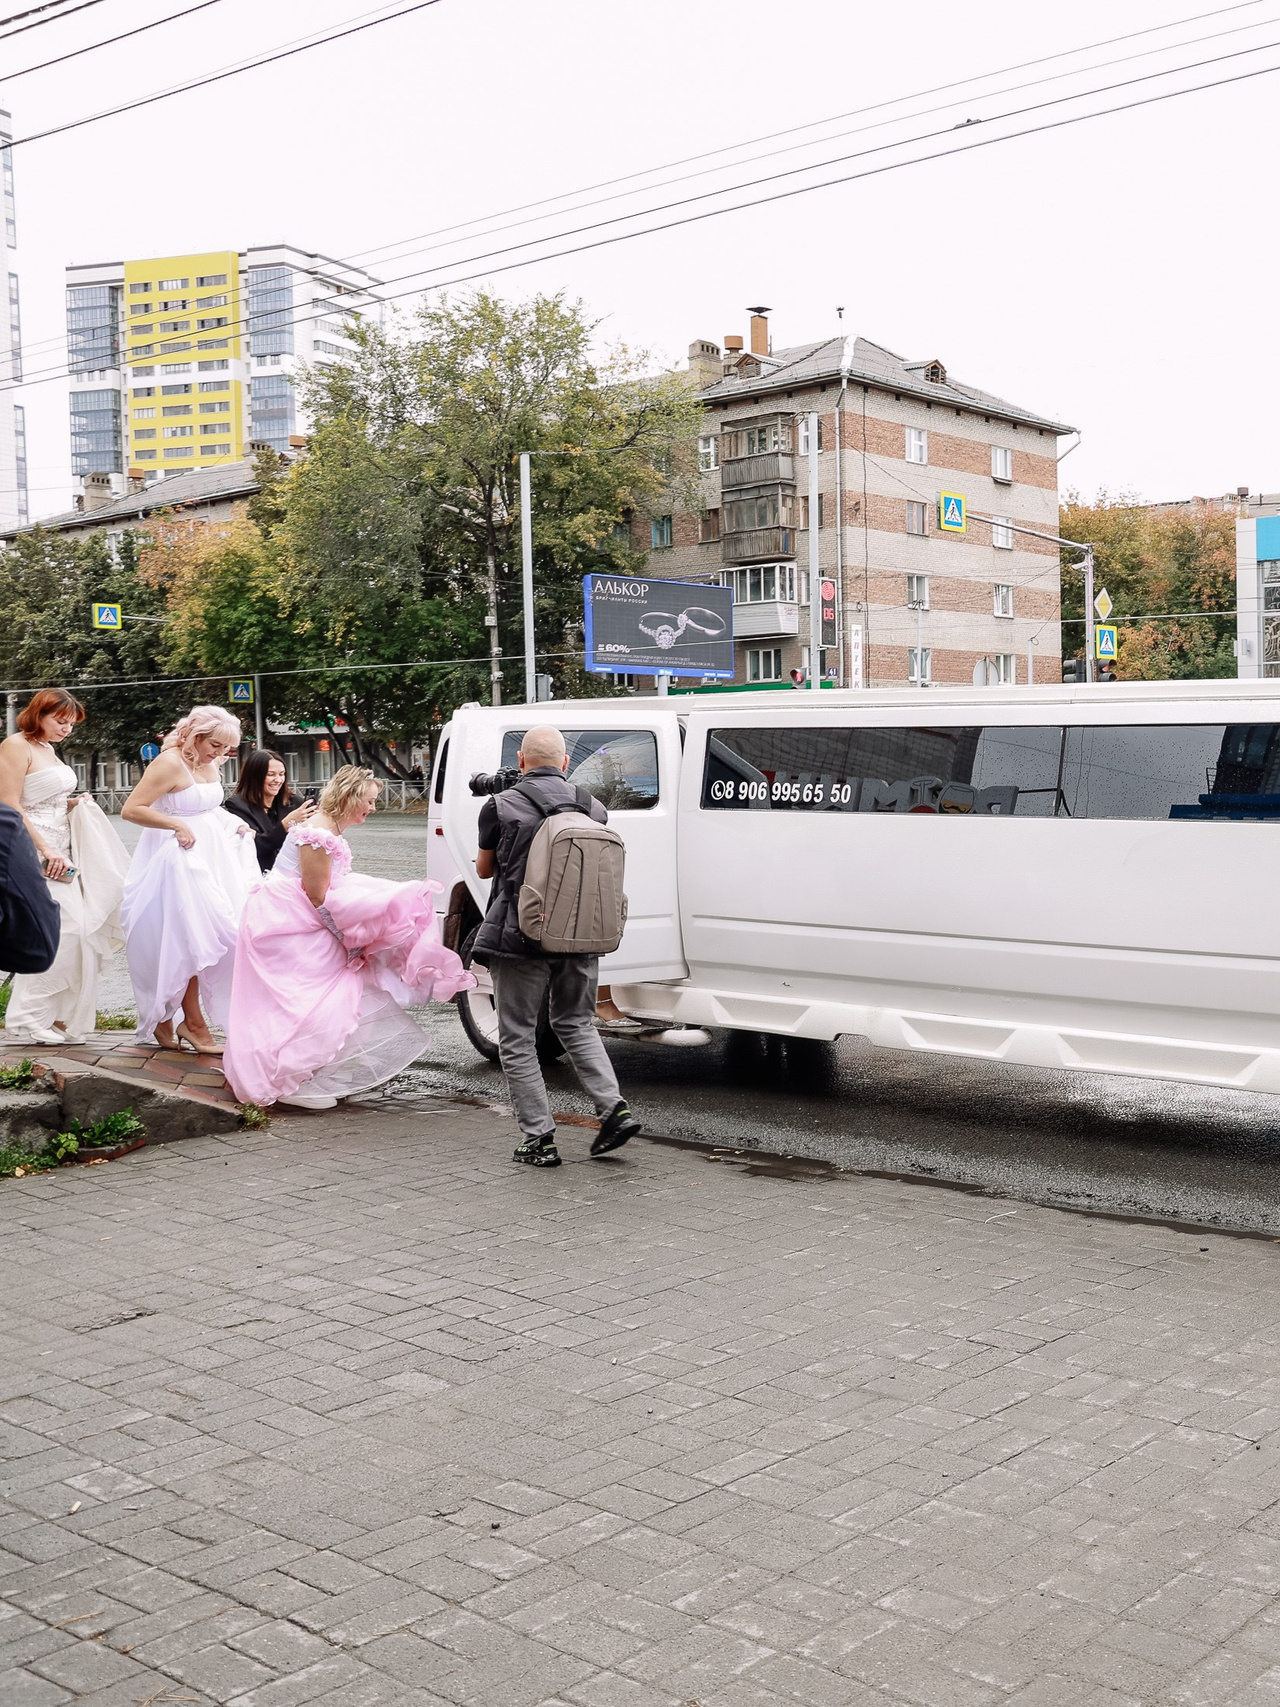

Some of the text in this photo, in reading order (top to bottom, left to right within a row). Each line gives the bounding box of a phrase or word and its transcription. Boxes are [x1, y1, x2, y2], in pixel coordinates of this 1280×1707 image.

[594, 580, 649, 597] АЛЬКОР
[725, 780, 734, 800] 8
[738, 781, 767, 801] 906
[771, 782, 801, 802] 995
[802, 783, 824, 803] 65
[830, 784, 852, 803] 50
